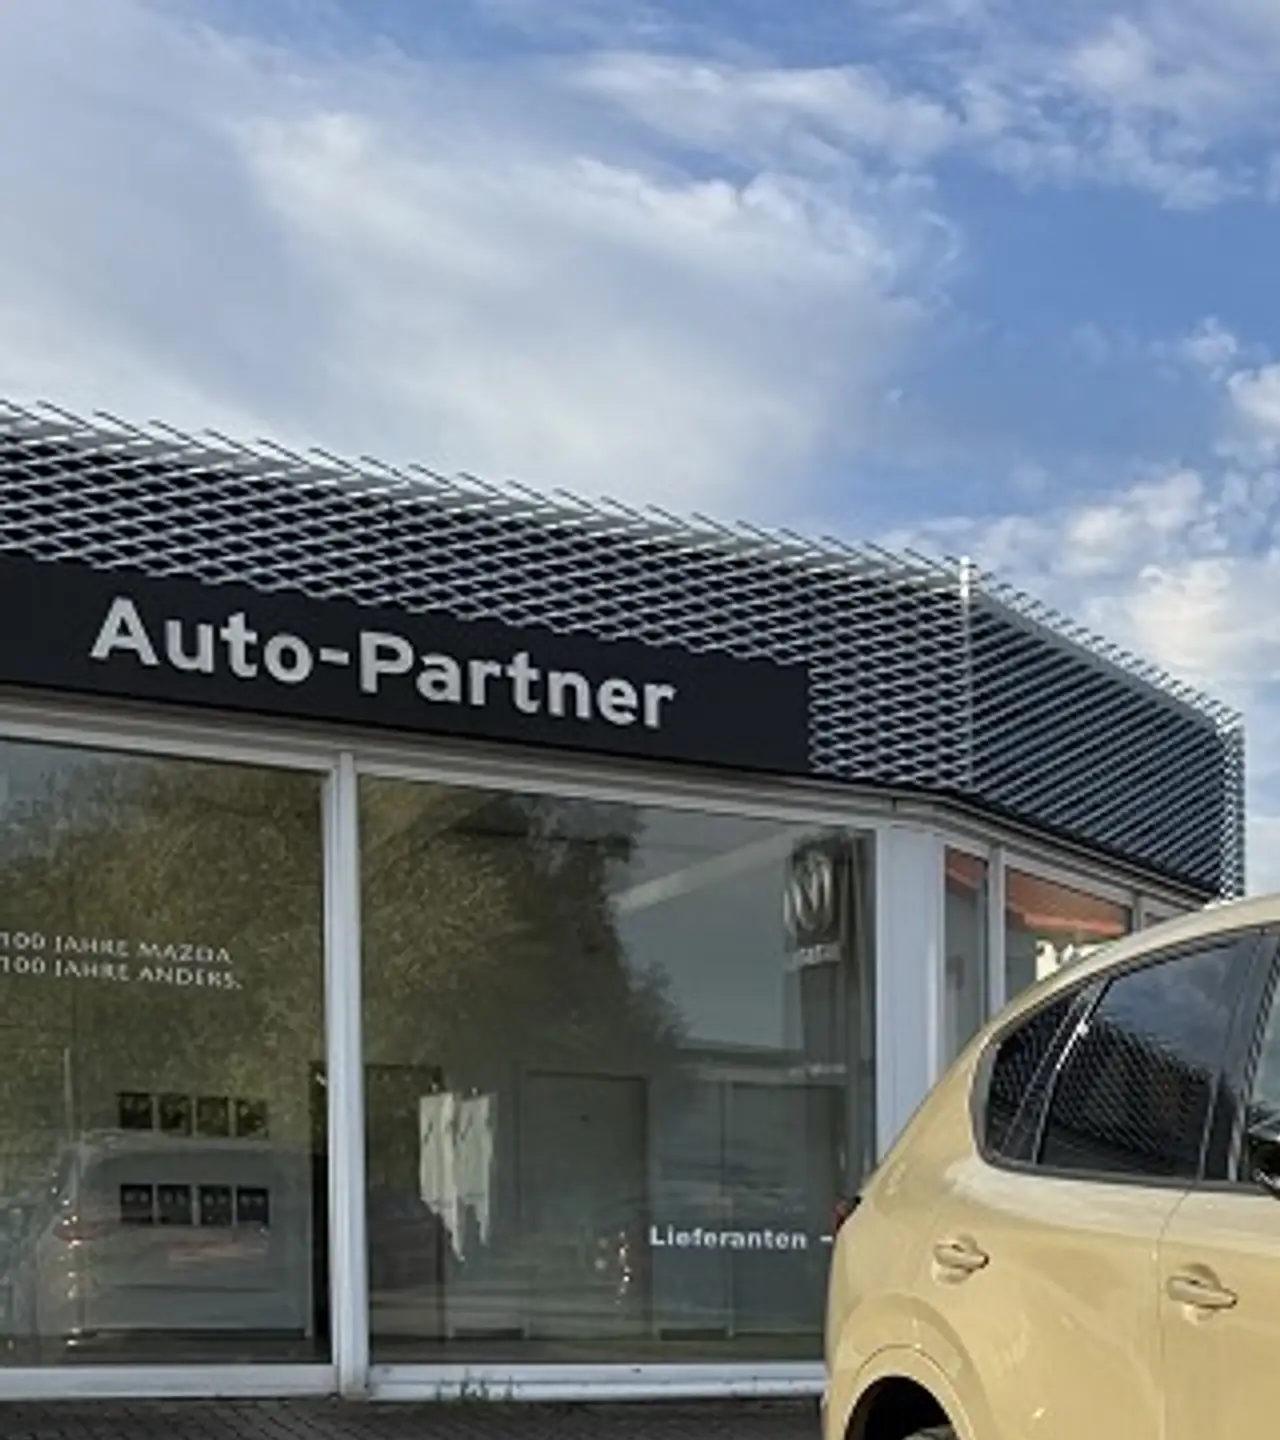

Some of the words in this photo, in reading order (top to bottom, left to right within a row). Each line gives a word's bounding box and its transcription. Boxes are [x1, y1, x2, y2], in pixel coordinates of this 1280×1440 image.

[91, 596, 677, 728] Auto-Partner
[0, 931, 47, 950] 100
[55, 935, 130, 957] JAHRE
[138, 942, 233, 965] MAZDA
[0, 955, 47, 975] 100
[55, 959, 130, 982] JAHRE
[650, 1224, 808, 1250] Lieferanten
